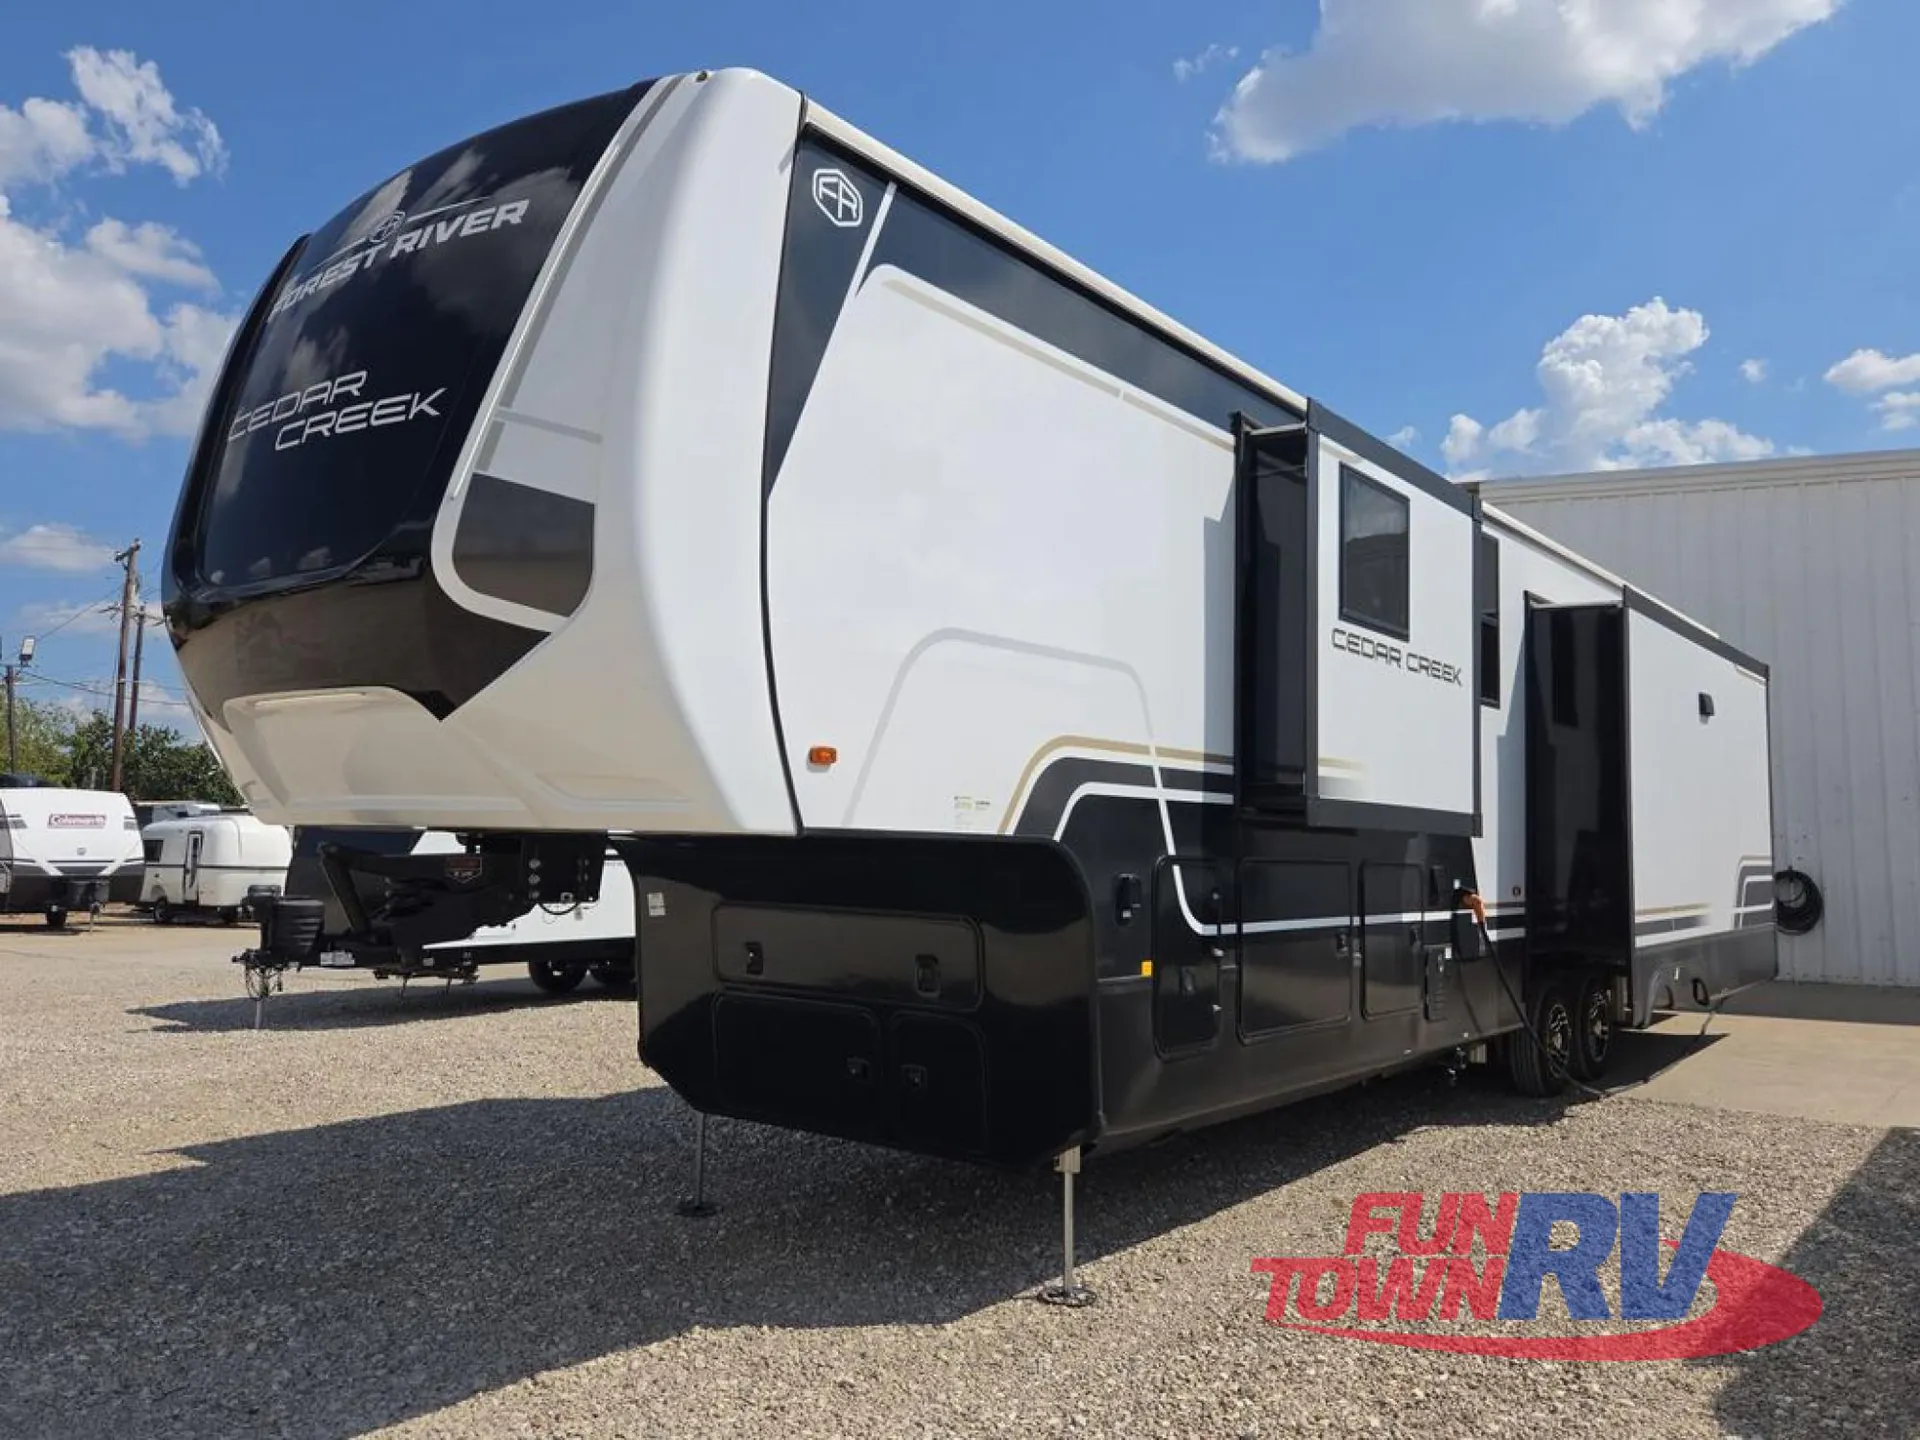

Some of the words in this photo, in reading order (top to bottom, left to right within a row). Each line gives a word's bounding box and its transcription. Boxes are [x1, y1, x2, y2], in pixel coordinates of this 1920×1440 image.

[267, 241, 388, 322] FOREST
[389, 198, 530, 260] RIVER
[228, 370, 368, 443] CEDAR
[274, 387, 448, 451] CREEK
[1331, 627, 1402, 669] CEDAR
[1405, 652, 1463, 687] CREEK
